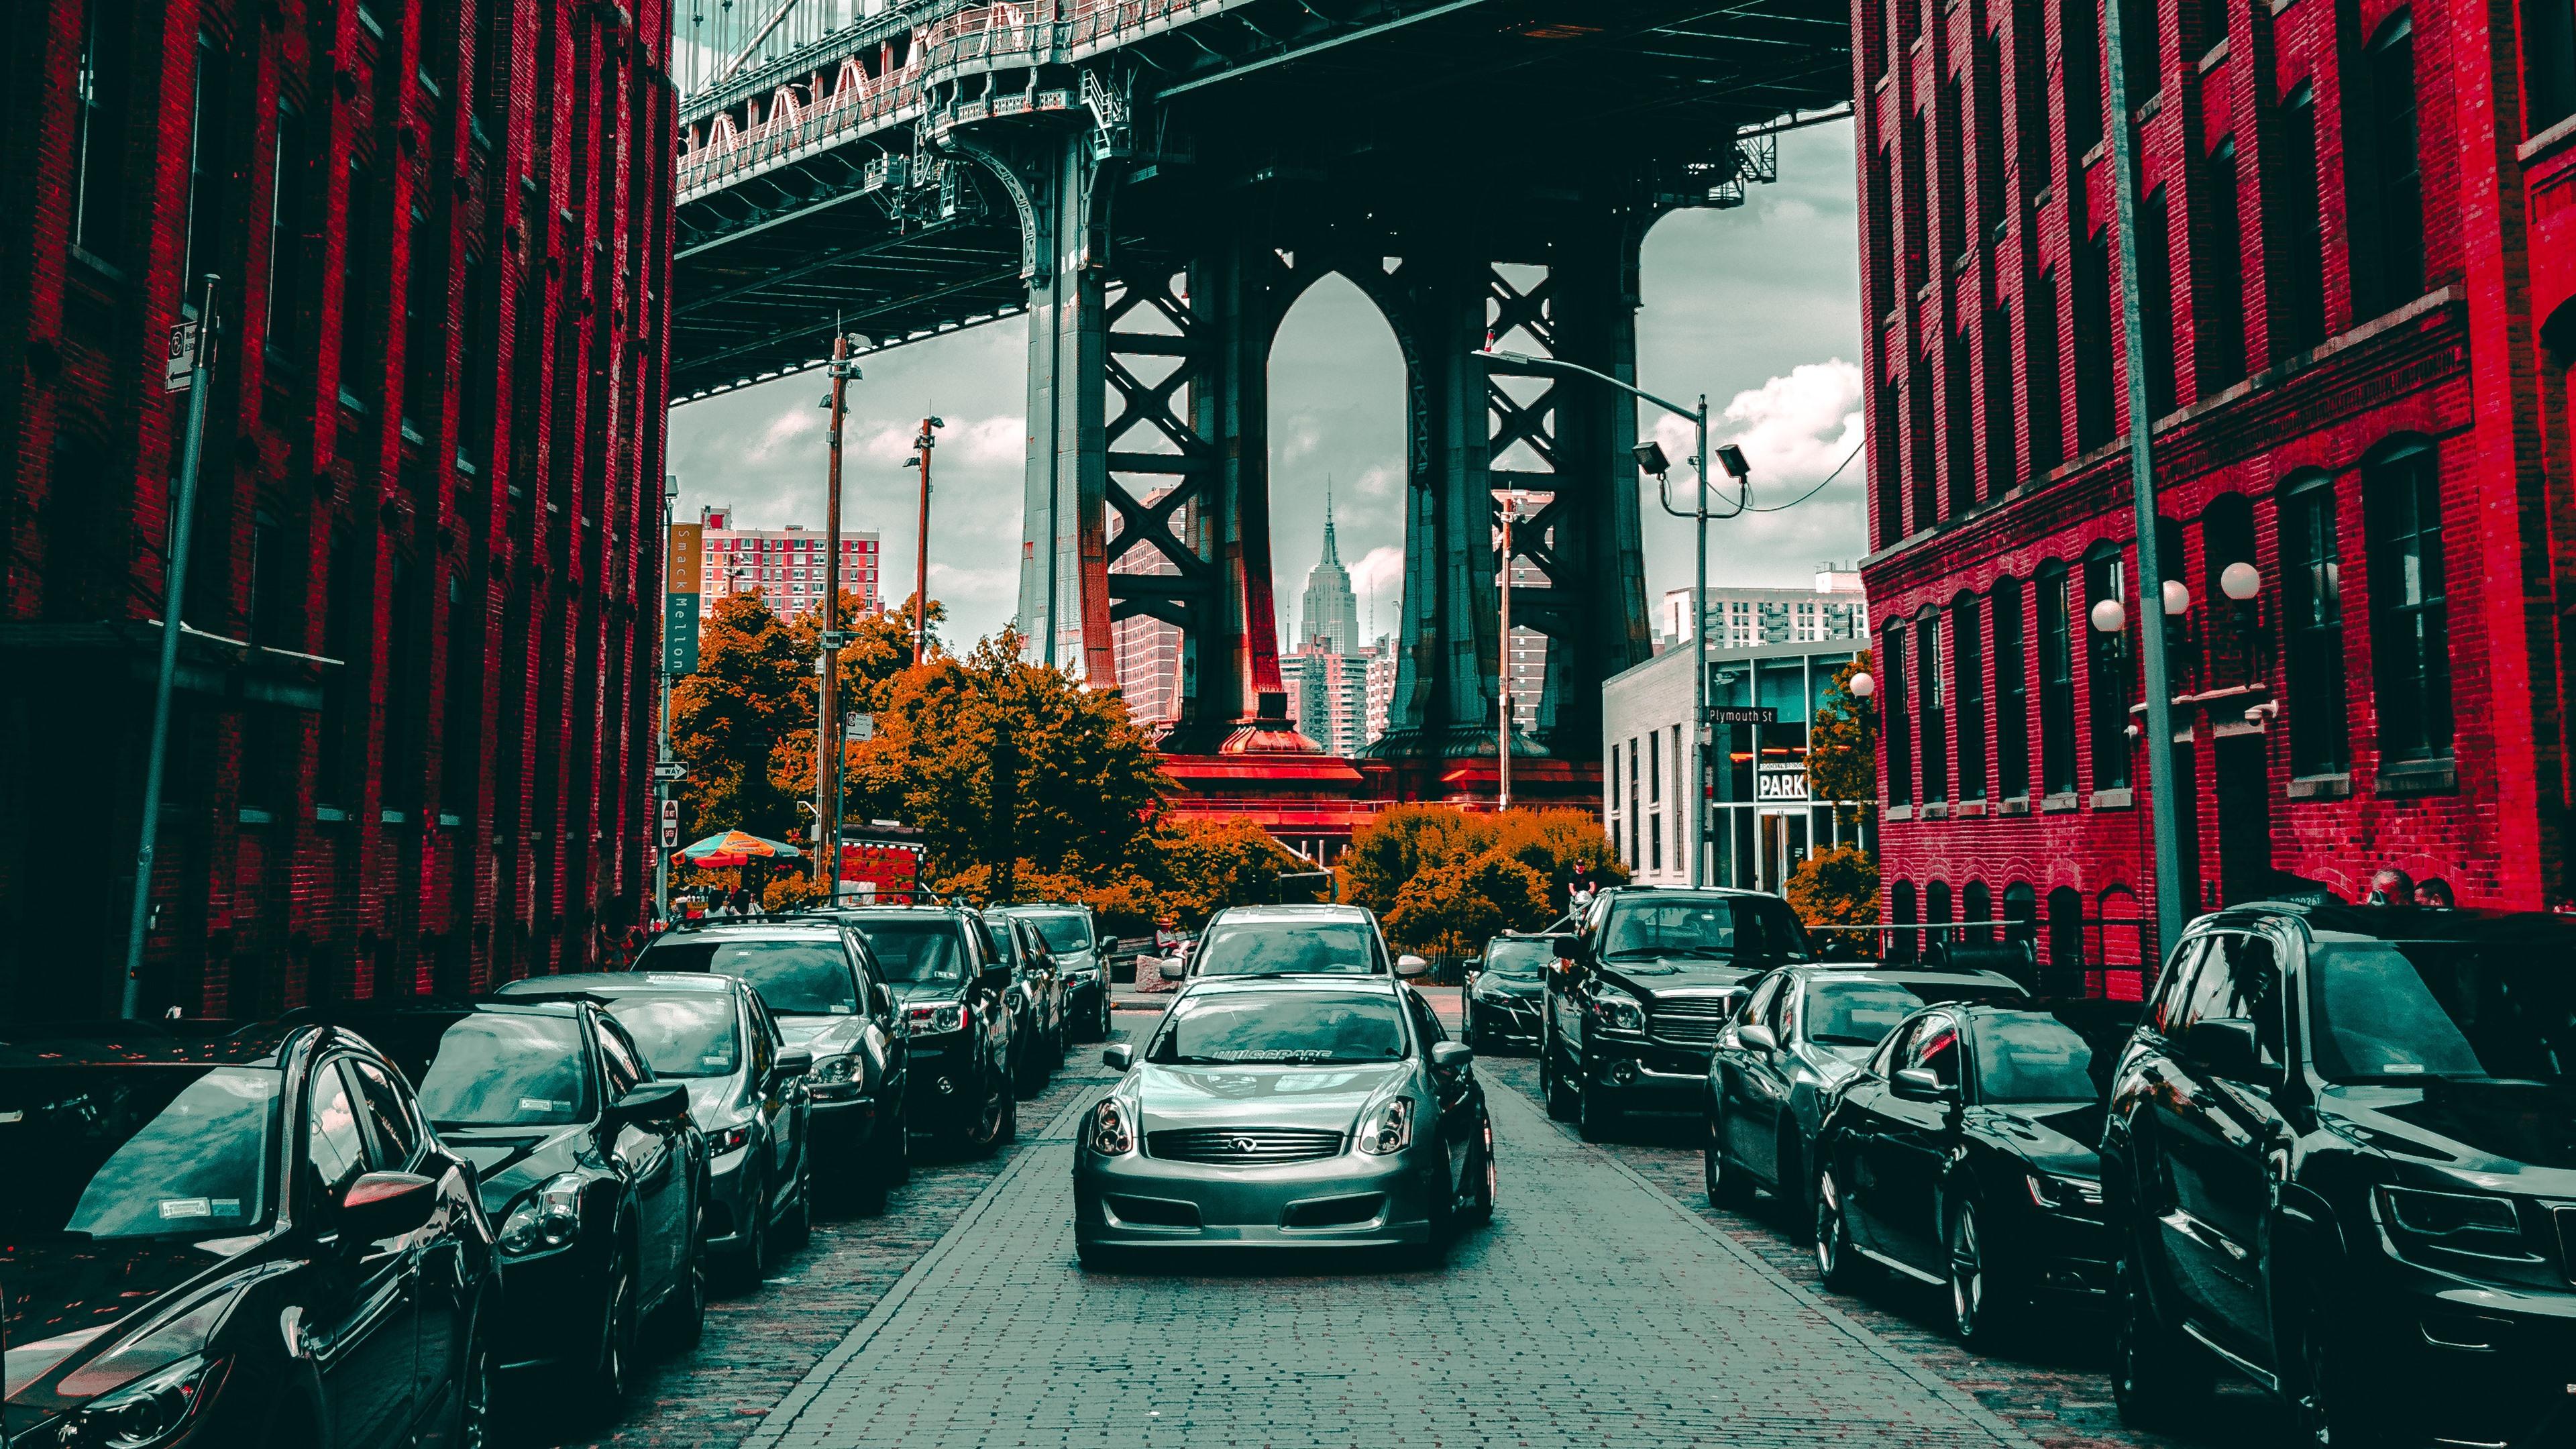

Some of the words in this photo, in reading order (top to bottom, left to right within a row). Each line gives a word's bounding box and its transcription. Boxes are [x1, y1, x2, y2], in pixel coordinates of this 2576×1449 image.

[676, 530, 690, 588] Smack
[674, 598, 688, 668] Mellon
[1709, 709, 1759, 724] Plymouth
[1762, 710, 1772, 722] St
[1760, 774, 1807, 796] PARK
